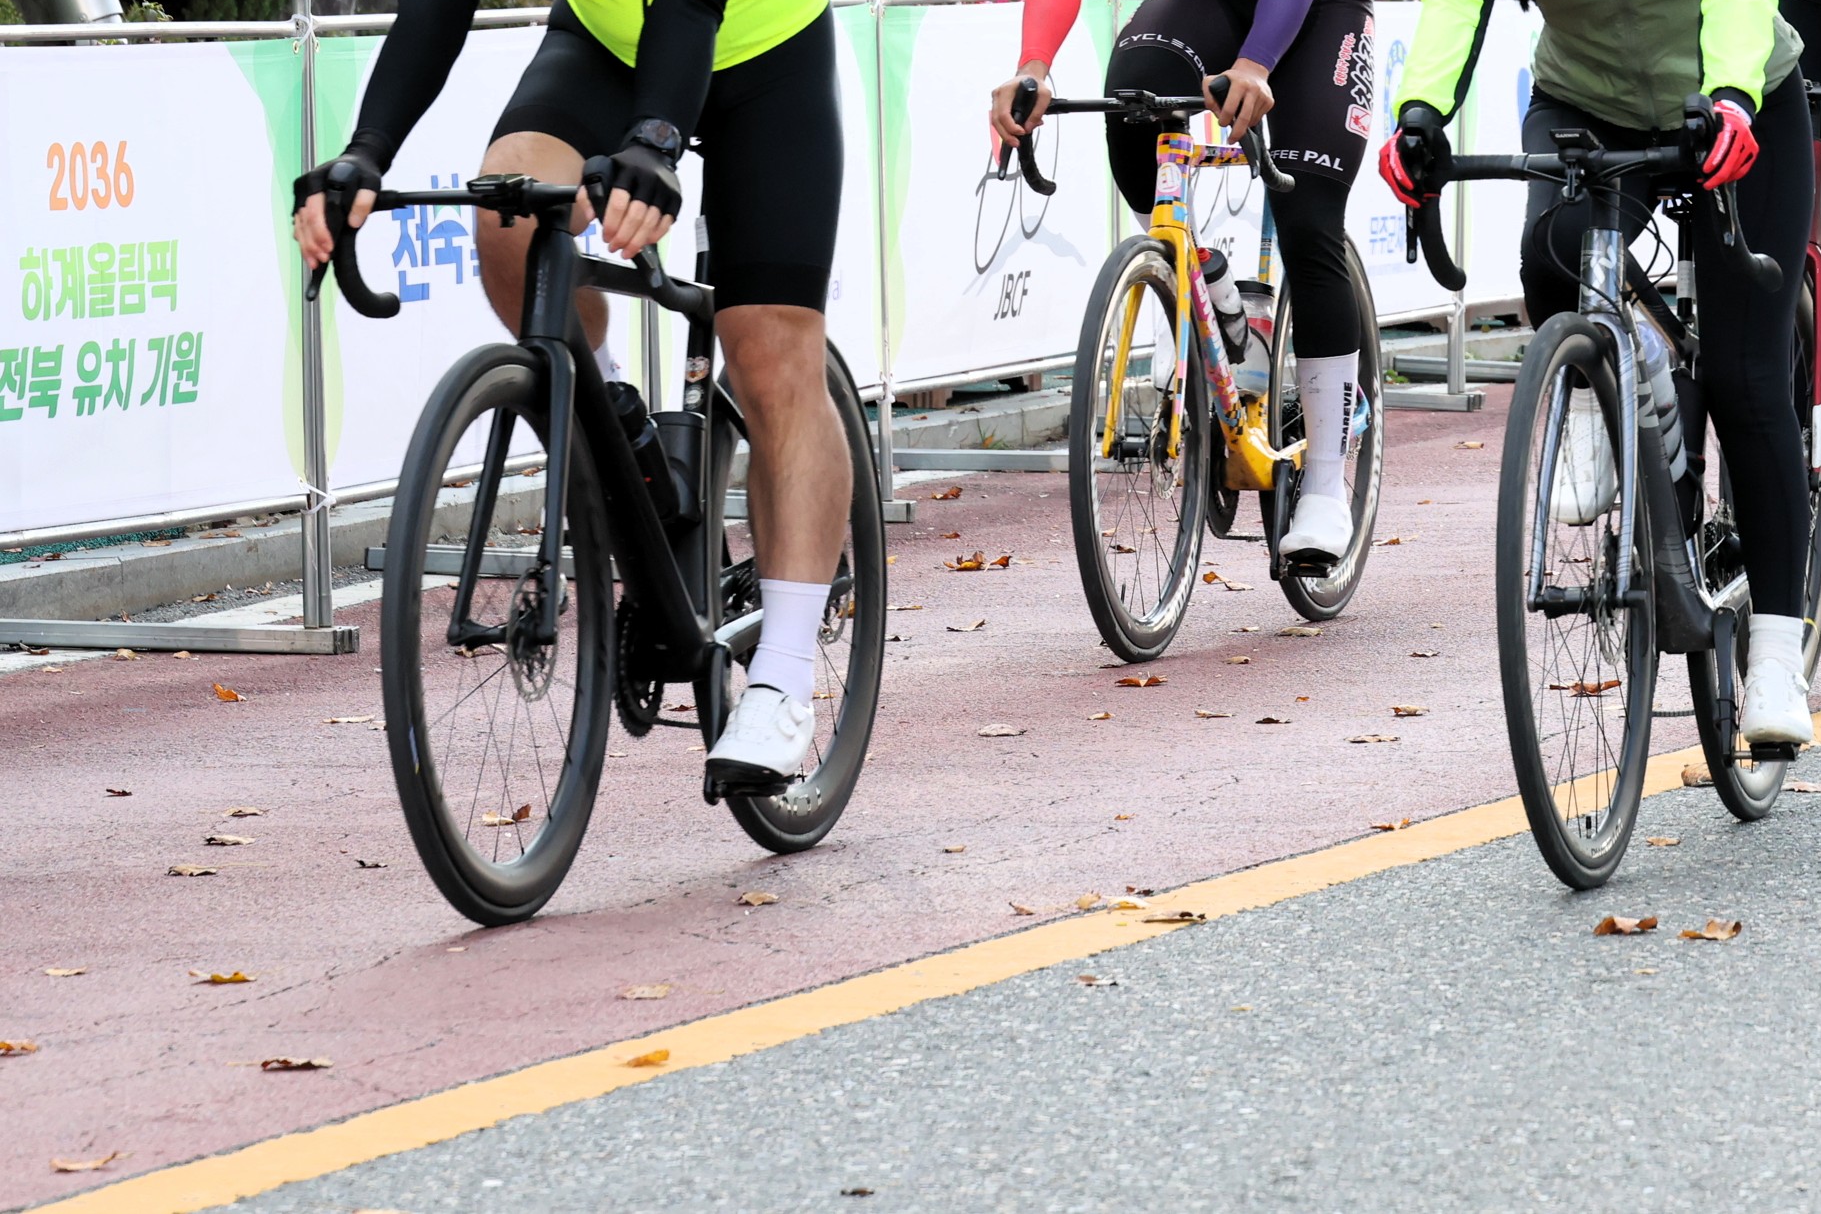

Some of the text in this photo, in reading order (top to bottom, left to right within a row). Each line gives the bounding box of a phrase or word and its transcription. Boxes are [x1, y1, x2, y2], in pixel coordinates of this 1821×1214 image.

[1118, 33, 1208, 77] CYCLEZON
[47, 140, 134, 211] 2036
[1303, 149, 1344, 172] PAL
[19, 239, 179, 321] 하계올림픽
[993, 270, 1031, 321] JBCF
[0, 331, 204, 422] 전북 유치 기원
